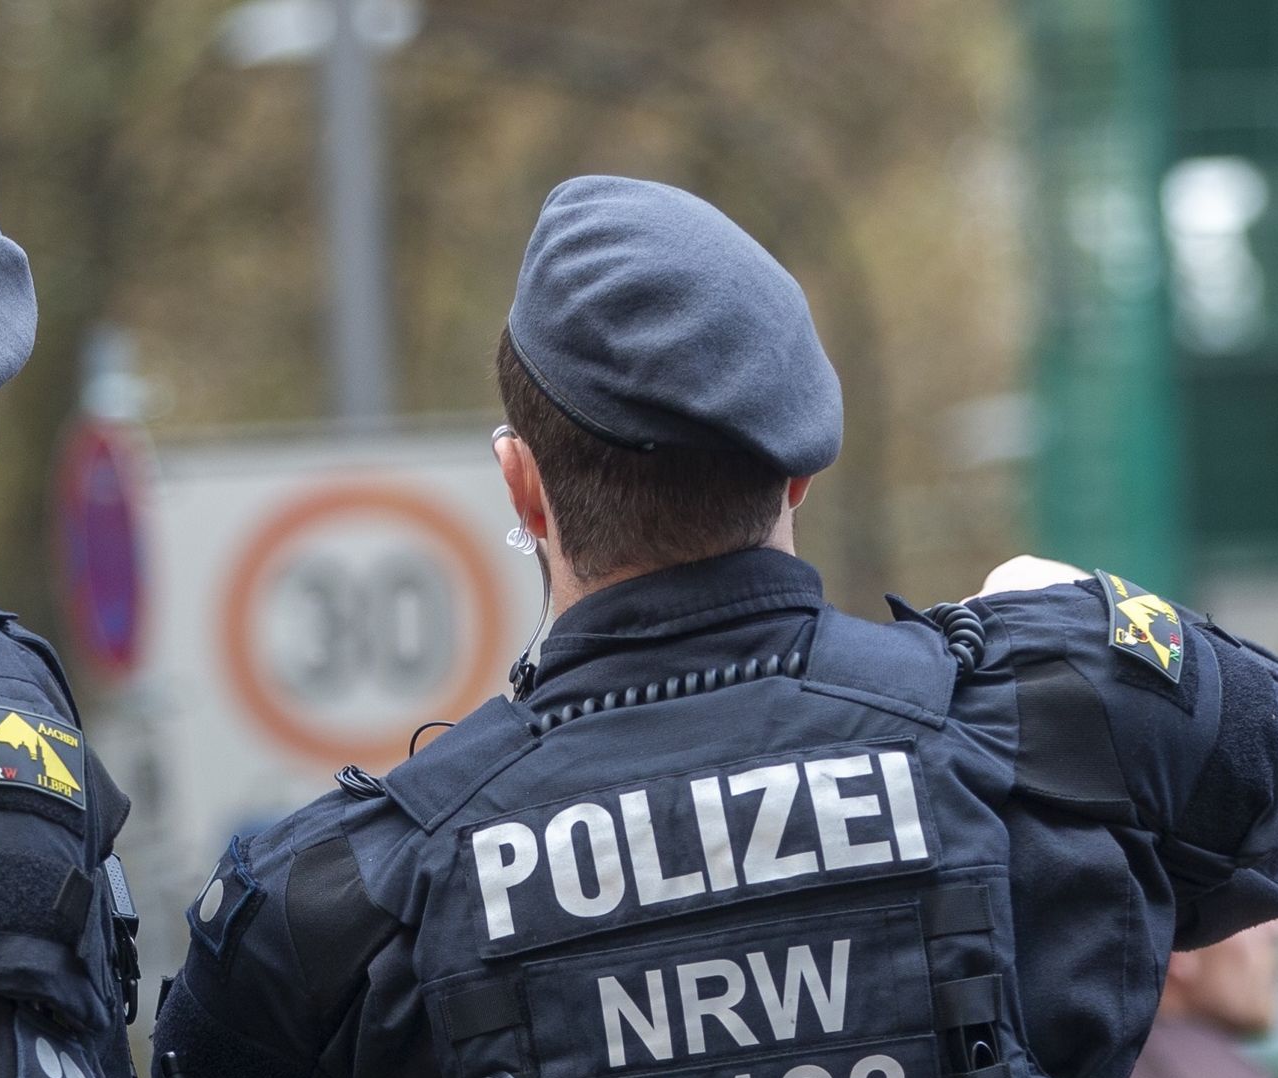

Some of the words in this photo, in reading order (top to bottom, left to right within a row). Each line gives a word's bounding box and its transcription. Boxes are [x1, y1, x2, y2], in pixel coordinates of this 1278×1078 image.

[288, 552, 453, 694] 30
[472, 751, 928, 940] POLIZEI
[597, 938, 851, 1067] NRW
